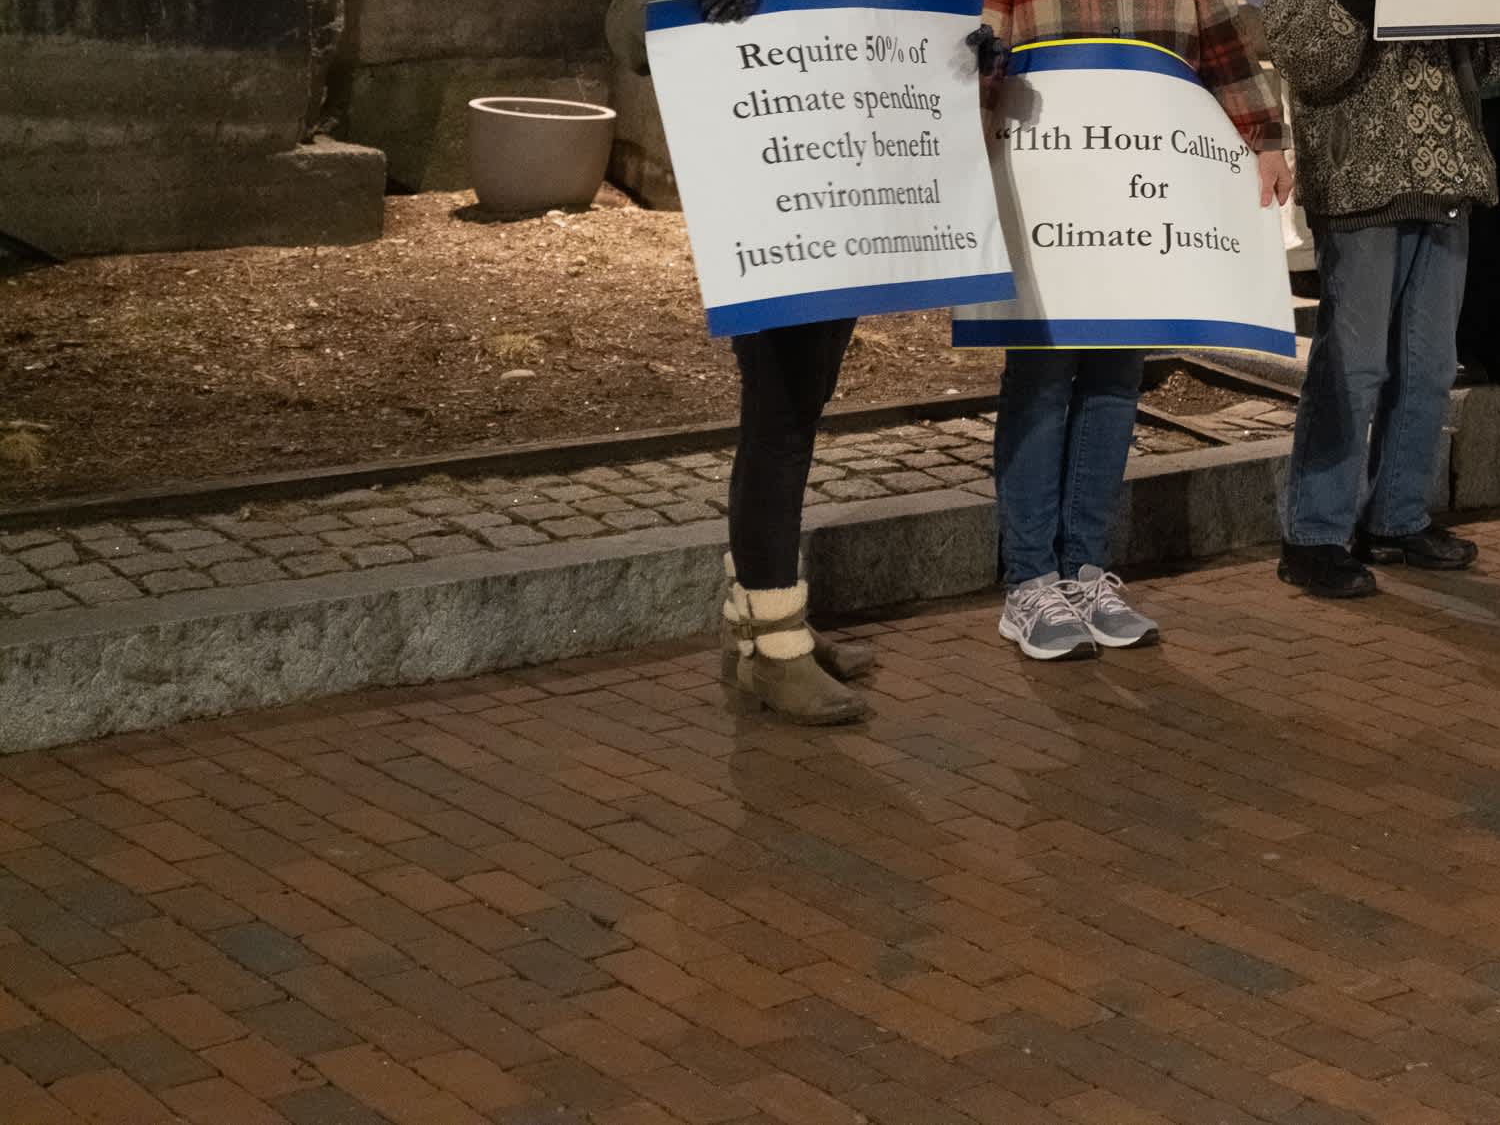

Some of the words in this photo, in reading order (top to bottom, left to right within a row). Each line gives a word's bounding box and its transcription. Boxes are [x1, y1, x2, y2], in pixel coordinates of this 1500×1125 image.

[736, 36, 859, 73] Require
[865, 35, 904, 63] 50%
[909, 38, 929, 64] of
[732, 88, 845, 119] climate
[854, 84, 942, 120] spending
[762, 131, 868, 167] directly
[872, 130, 941, 157] benefit
[1082, 125, 1163, 151] Hour
[776, 179, 941, 213] environmental
[1128, 173, 1169, 199] for
[735, 234, 837, 277] justice
[845, 225, 978, 257] communities
[1032, 222, 1152, 248] Climate
[1160, 222, 1241, 254] Justice
